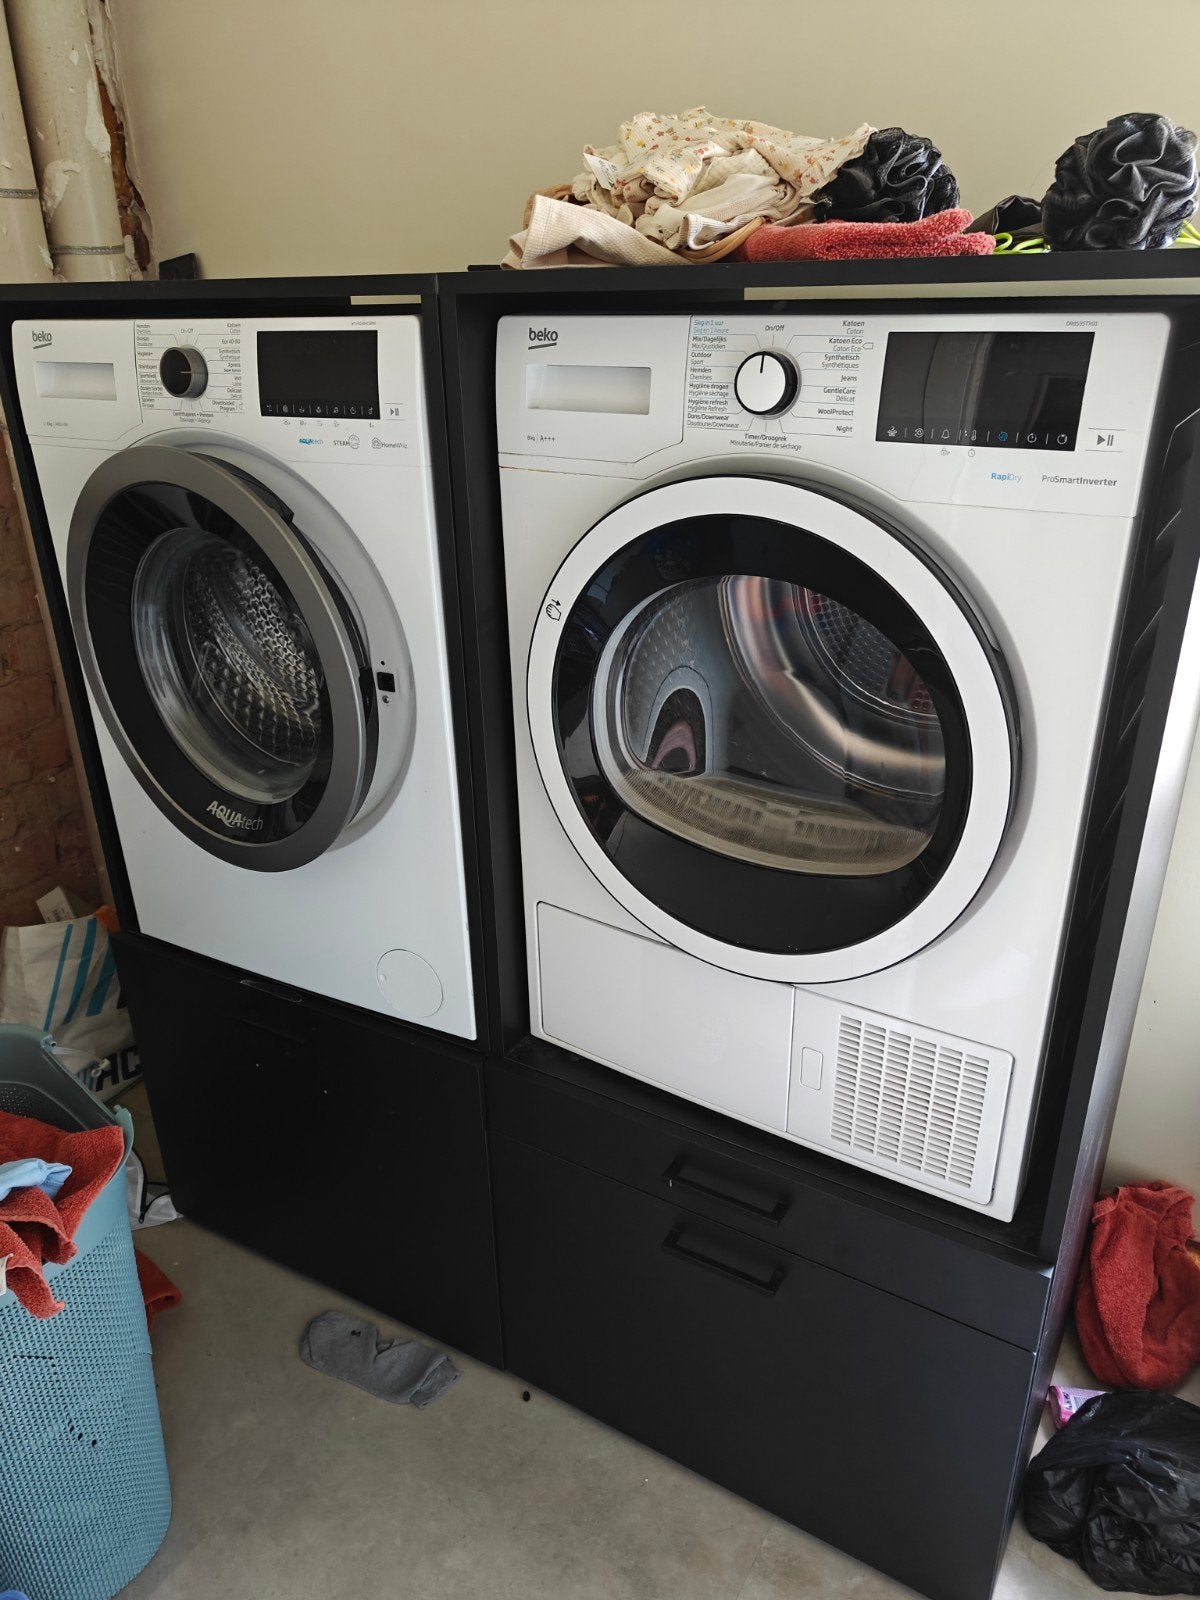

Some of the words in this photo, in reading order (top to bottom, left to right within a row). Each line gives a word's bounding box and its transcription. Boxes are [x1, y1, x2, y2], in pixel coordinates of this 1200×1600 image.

[32, 330, 52, 342] beko
[528, 327, 558, 341] beko
[824, 353, 860, 361] Synthetisch
[823, 387, 856, 395] GentleCare
[836, 425, 853, 433] Night
[540, 434, 556, 442] A+++
[744, 433, 787, 442] Timer/Droogrek
[333, 439, 350, 447] STEAM
[990, 472, 1023, 482] RapiDry
[1041, 473, 1118, 487] ProSmartInverter
[206, 800, 263, 830] AQUAtech
